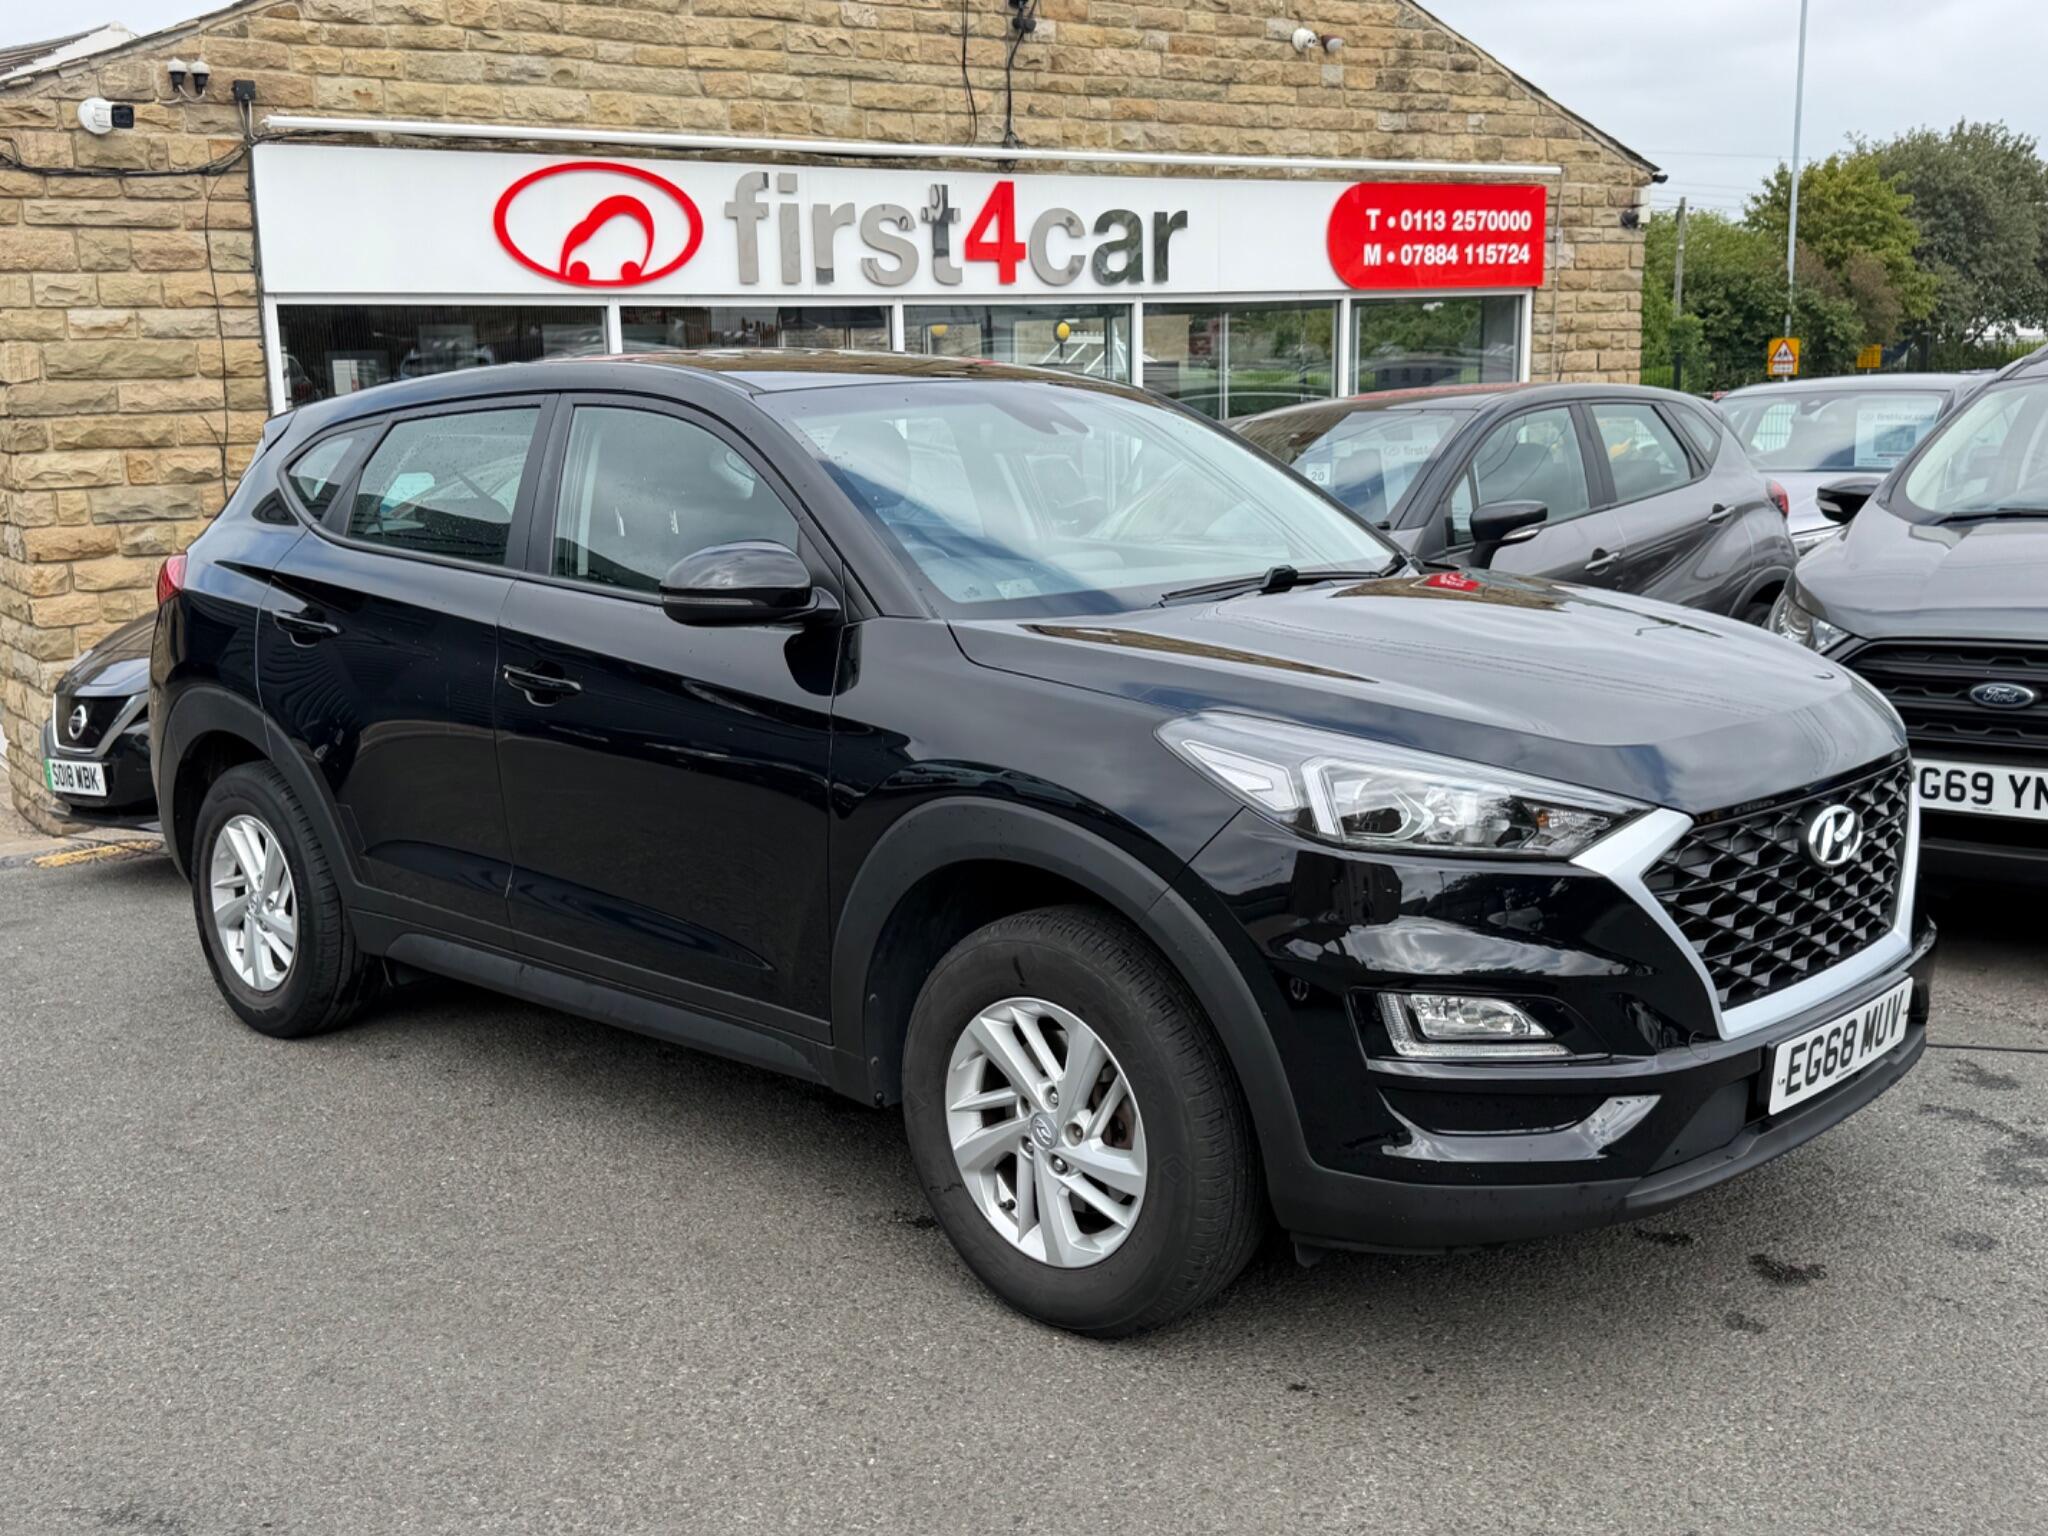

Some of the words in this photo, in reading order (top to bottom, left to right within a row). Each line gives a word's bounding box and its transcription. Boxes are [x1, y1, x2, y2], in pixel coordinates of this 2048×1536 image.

[724, 170, 1188, 287] first4car
[1365, 208, 1381, 231] T
[1400, 209, 1446, 231] 0113
[1452, 209, 1532, 232] 2570000
[1363, 243, 1382, 266] M
[1400, 243, 1458, 266] 07884
[1464, 243, 1530, 265] 115724
[1983, 686, 2019, 702] Ford
[1919, 767, 1993, 806] G69
[1785, 1018, 1857, 1097] EG68
[1860, 989, 1904, 1058] MUV
